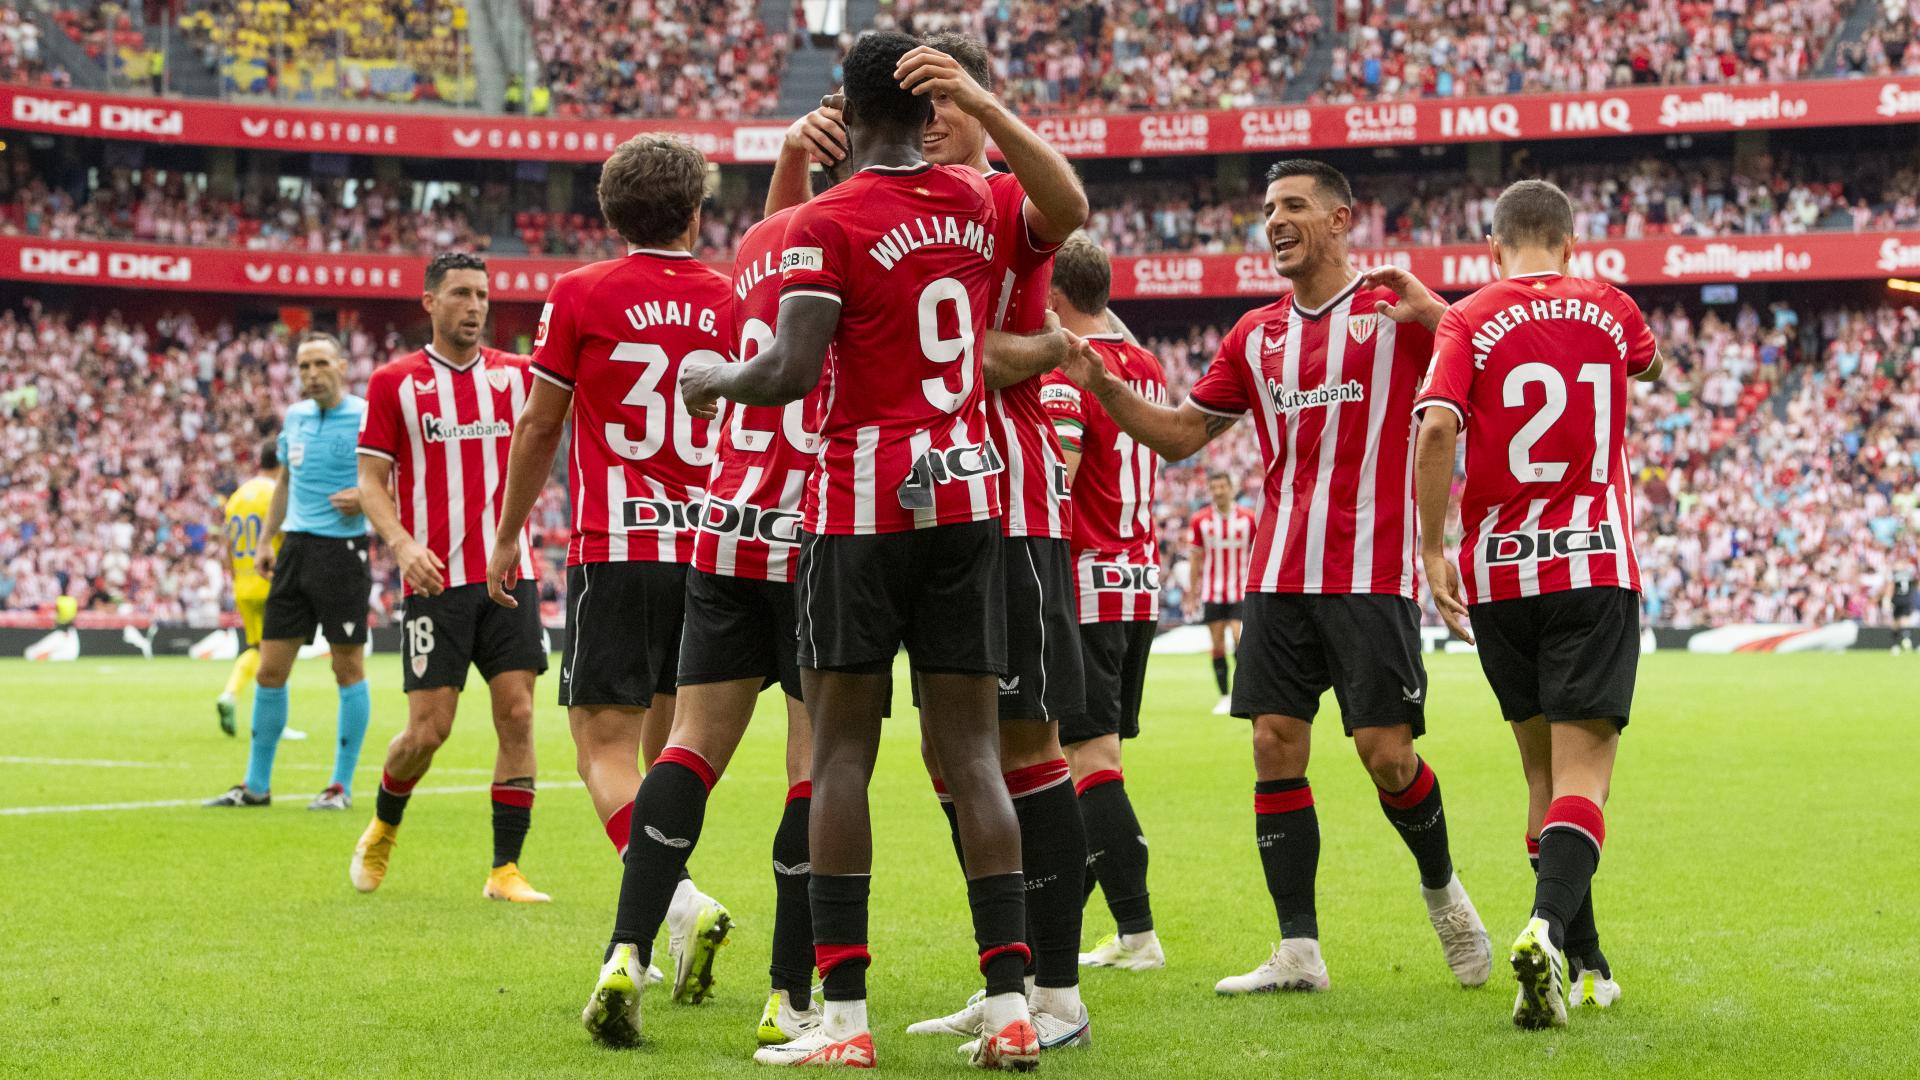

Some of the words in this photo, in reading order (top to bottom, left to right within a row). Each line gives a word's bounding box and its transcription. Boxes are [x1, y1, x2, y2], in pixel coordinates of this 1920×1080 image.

[12, 96, 91, 128] DIGI
[101, 105, 183, 136] DIGI
[1345, 103, 1417, 128] CLUB
[1550, 98, 1633, 133] IMQ
[1876, 83, 1920, 117] San
[273, 119, 398, 145] CASTORE
[1037, 118, 1107, 142] CLUB
[1140, 114, 1209, 138] CLUB
[1241, 108, 1312, 133] CLUB
[1440, 108, 1521, 137] IMQ
[488, 128, 616, 151] CASTORE
[869, 215, 995, 271] WILLIAMS
[1876, 238, 1920, 272] San
[20, 247, 99, 277] DIGI
[108, 253, 191, 283] DIGI
[277, 263, 401, 288] CASTORE
[1134, 258, 1204, 281] CLUB
[1442, 255, 1499, 285] IM
[1567, 248, 1629, 284] MQ
[625, 300, 692, 331] UNAI
[698, 307, 718, 337] G.
[1472, 302, 1531, 371] ANDER
[1530, 298, 1629, 361] HERRERA
[918, 277, 975, 414] 9
[605, 341, 728, 467] 30
[1268, 381, 1363, 412] Kutxabank
[425, 415, 509, 440] Kutxabank
[1502, 361, 1612, 485] 21
[1113, 431, 1151, 539] 11
[230, 514, 261, 559] 20
[700, 500, 803, 544] DIG
[1485, 523, 1617, 563] DIGI
[406, 615, 434, 657] 18
